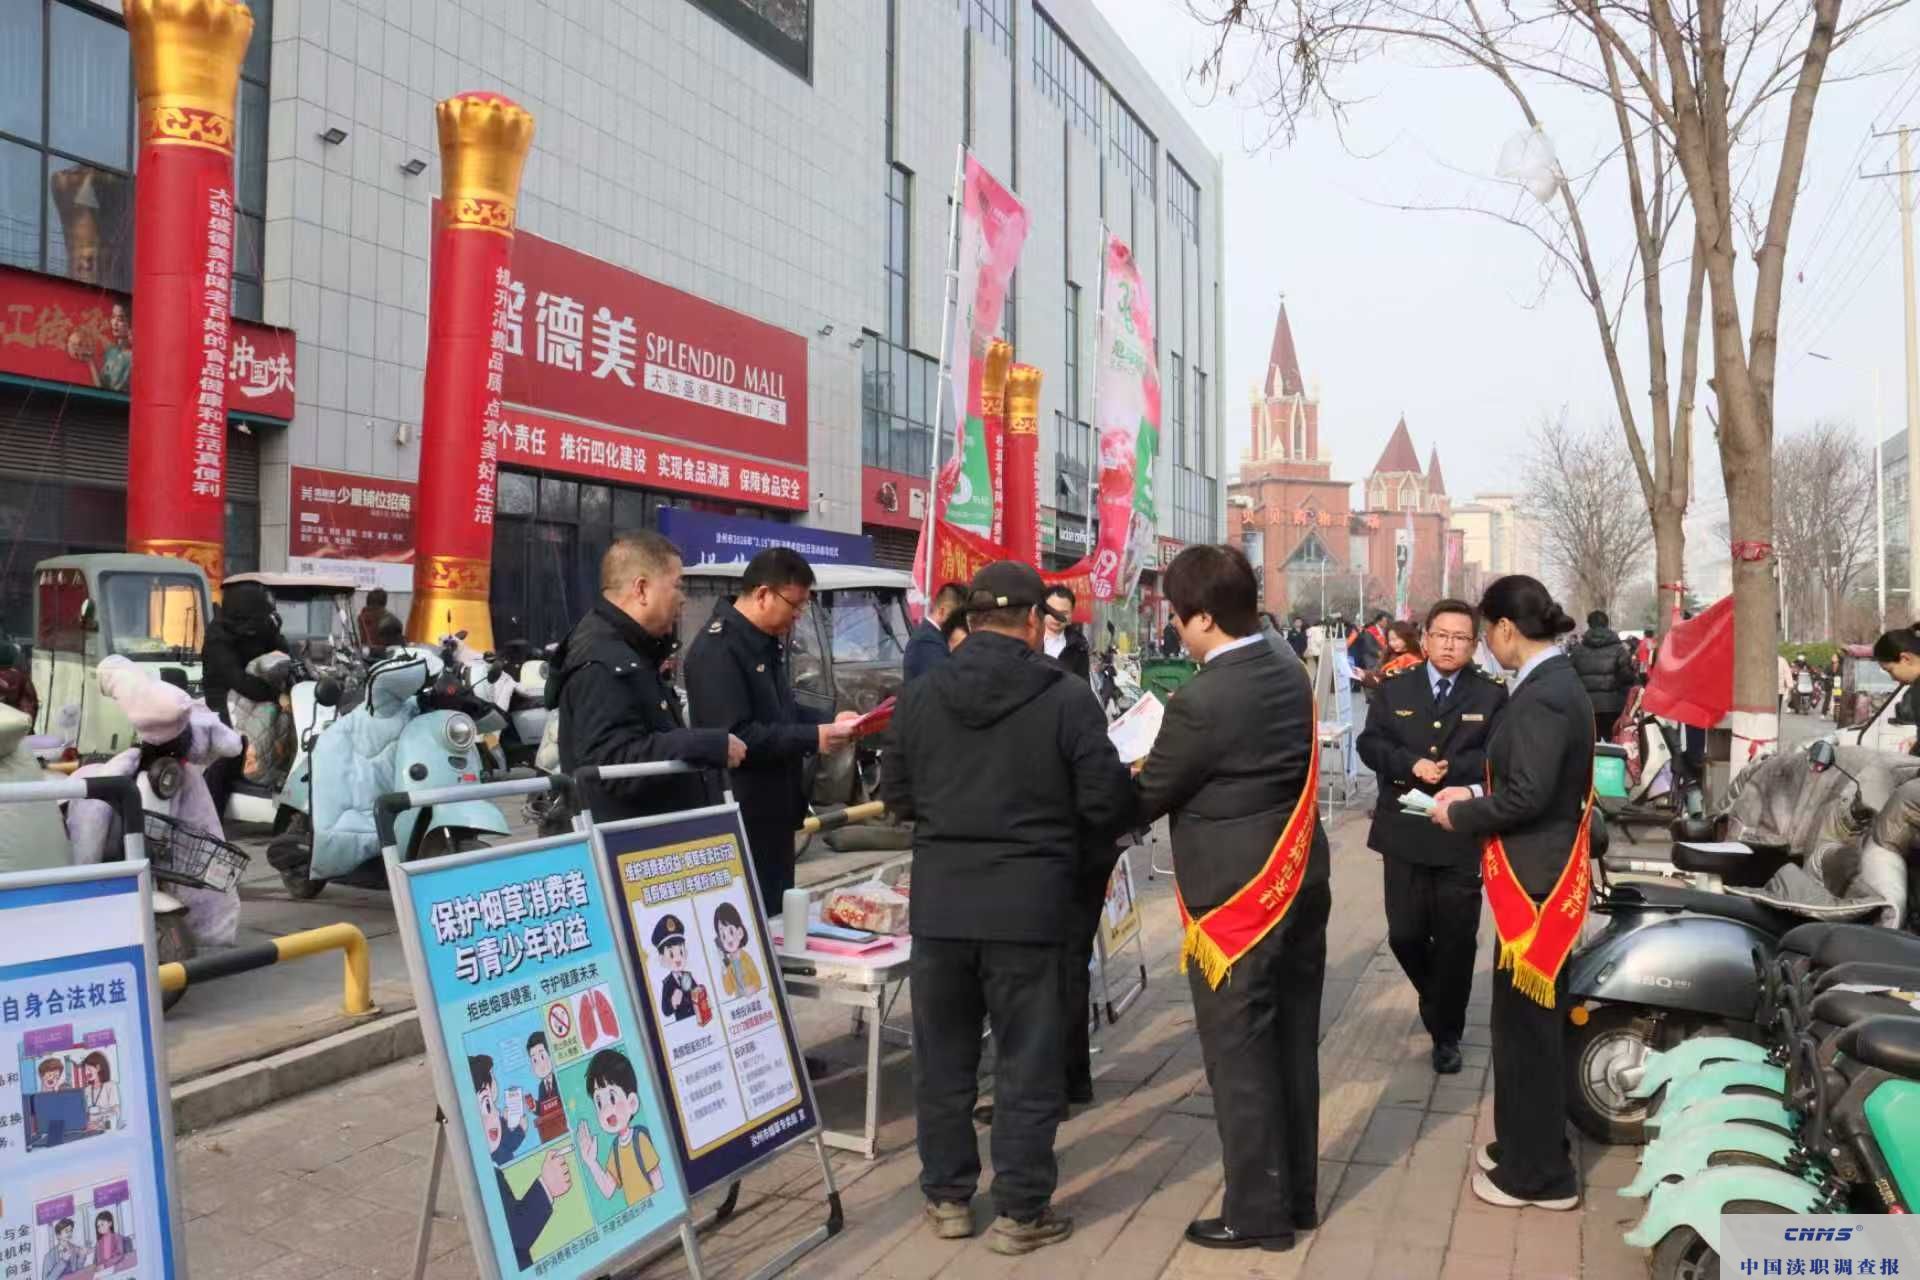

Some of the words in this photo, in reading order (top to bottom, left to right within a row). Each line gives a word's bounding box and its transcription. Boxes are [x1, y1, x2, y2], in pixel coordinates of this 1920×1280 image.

[231, 336, 294, 397] 中国味
[645, 332, 736, 386] SPLENDID
[744, 367, 785, 400] MALL
[473, 398, 503, 525] 点亮美好生活
[498, 420, 546, 456] 个责任
[560, 432, 647, 475] 推行四化建设
[657, 452, 730, 489] 实现食品溯源
[739, 468, 801, 501] 保障食品安全
[337, 485, 411, 513] 少量铺位招商
[430, 870, 591, 946] 保护烟草消费者
[455, 913, 593, 986] 与青少年权益
[2, 978, 127, 1023] 自身合法权益
